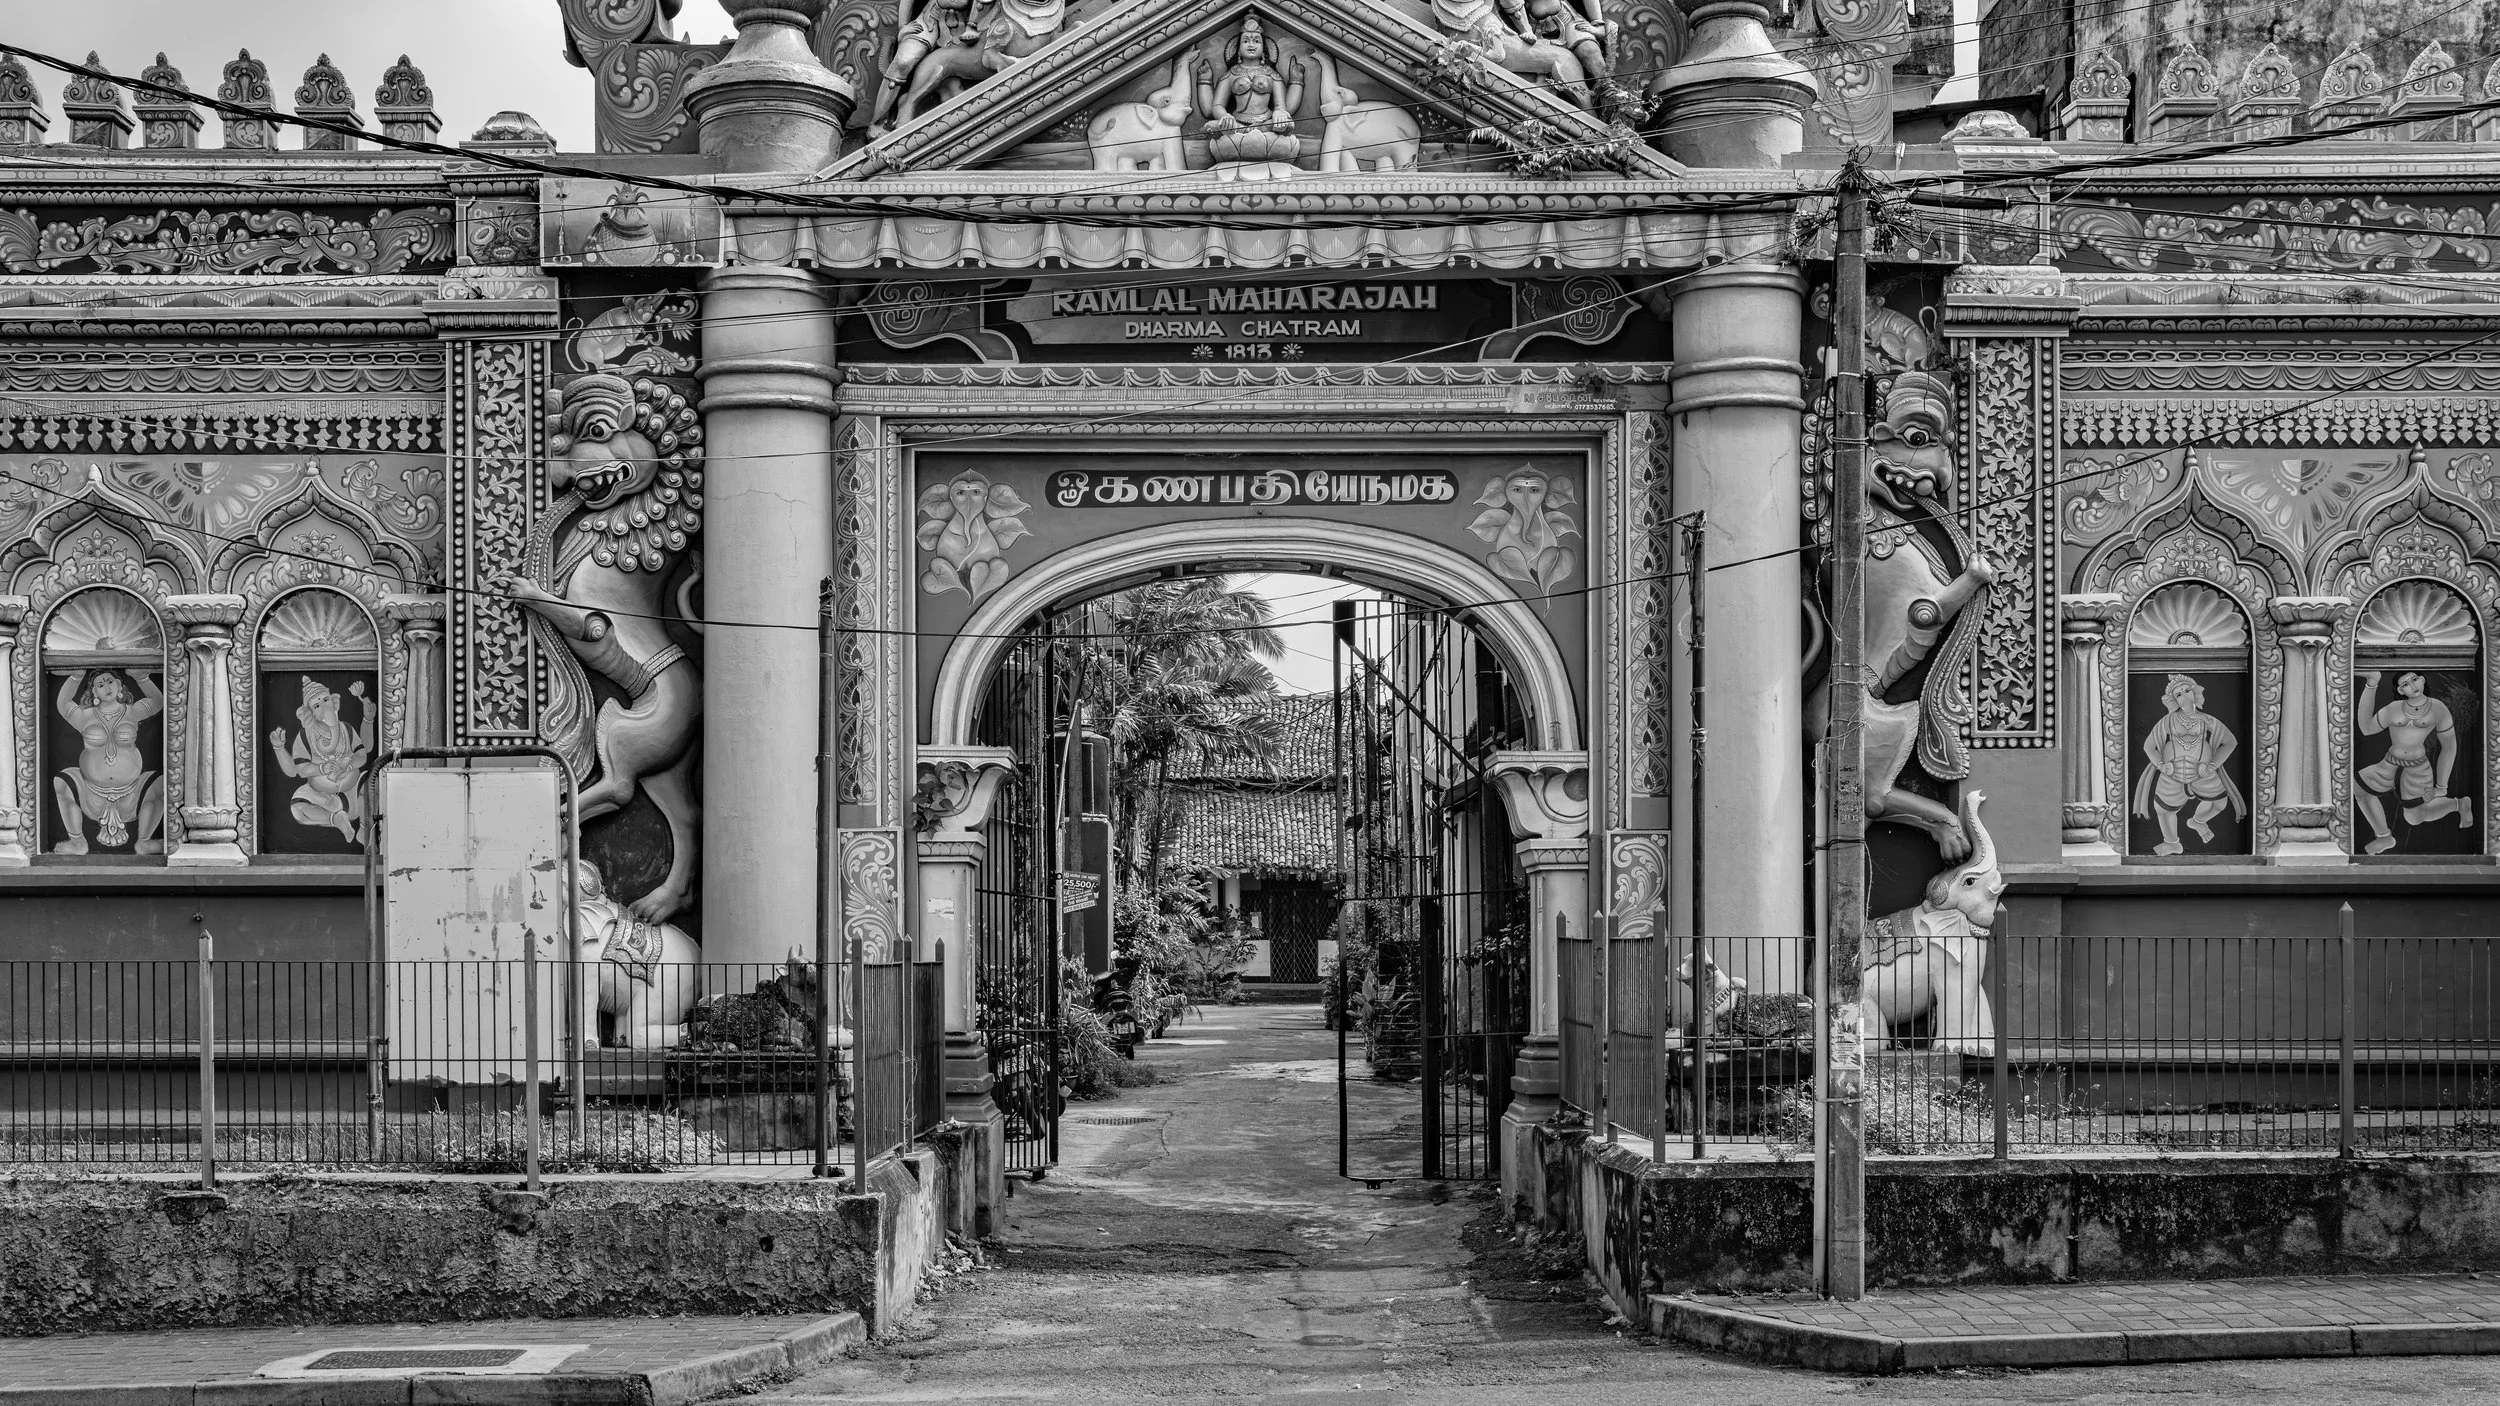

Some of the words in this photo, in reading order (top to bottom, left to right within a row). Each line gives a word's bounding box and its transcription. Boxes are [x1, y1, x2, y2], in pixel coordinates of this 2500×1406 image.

[1052, 286, 1199, 315] RAMLAL
[1207, 285, 1440, 314] MAHARAJAH
[1125, 320, 1226, 339] DHARMA
[1240, 319, 1361, 337] CHATRAM
[1224, 343, 1273, 361] 1813
